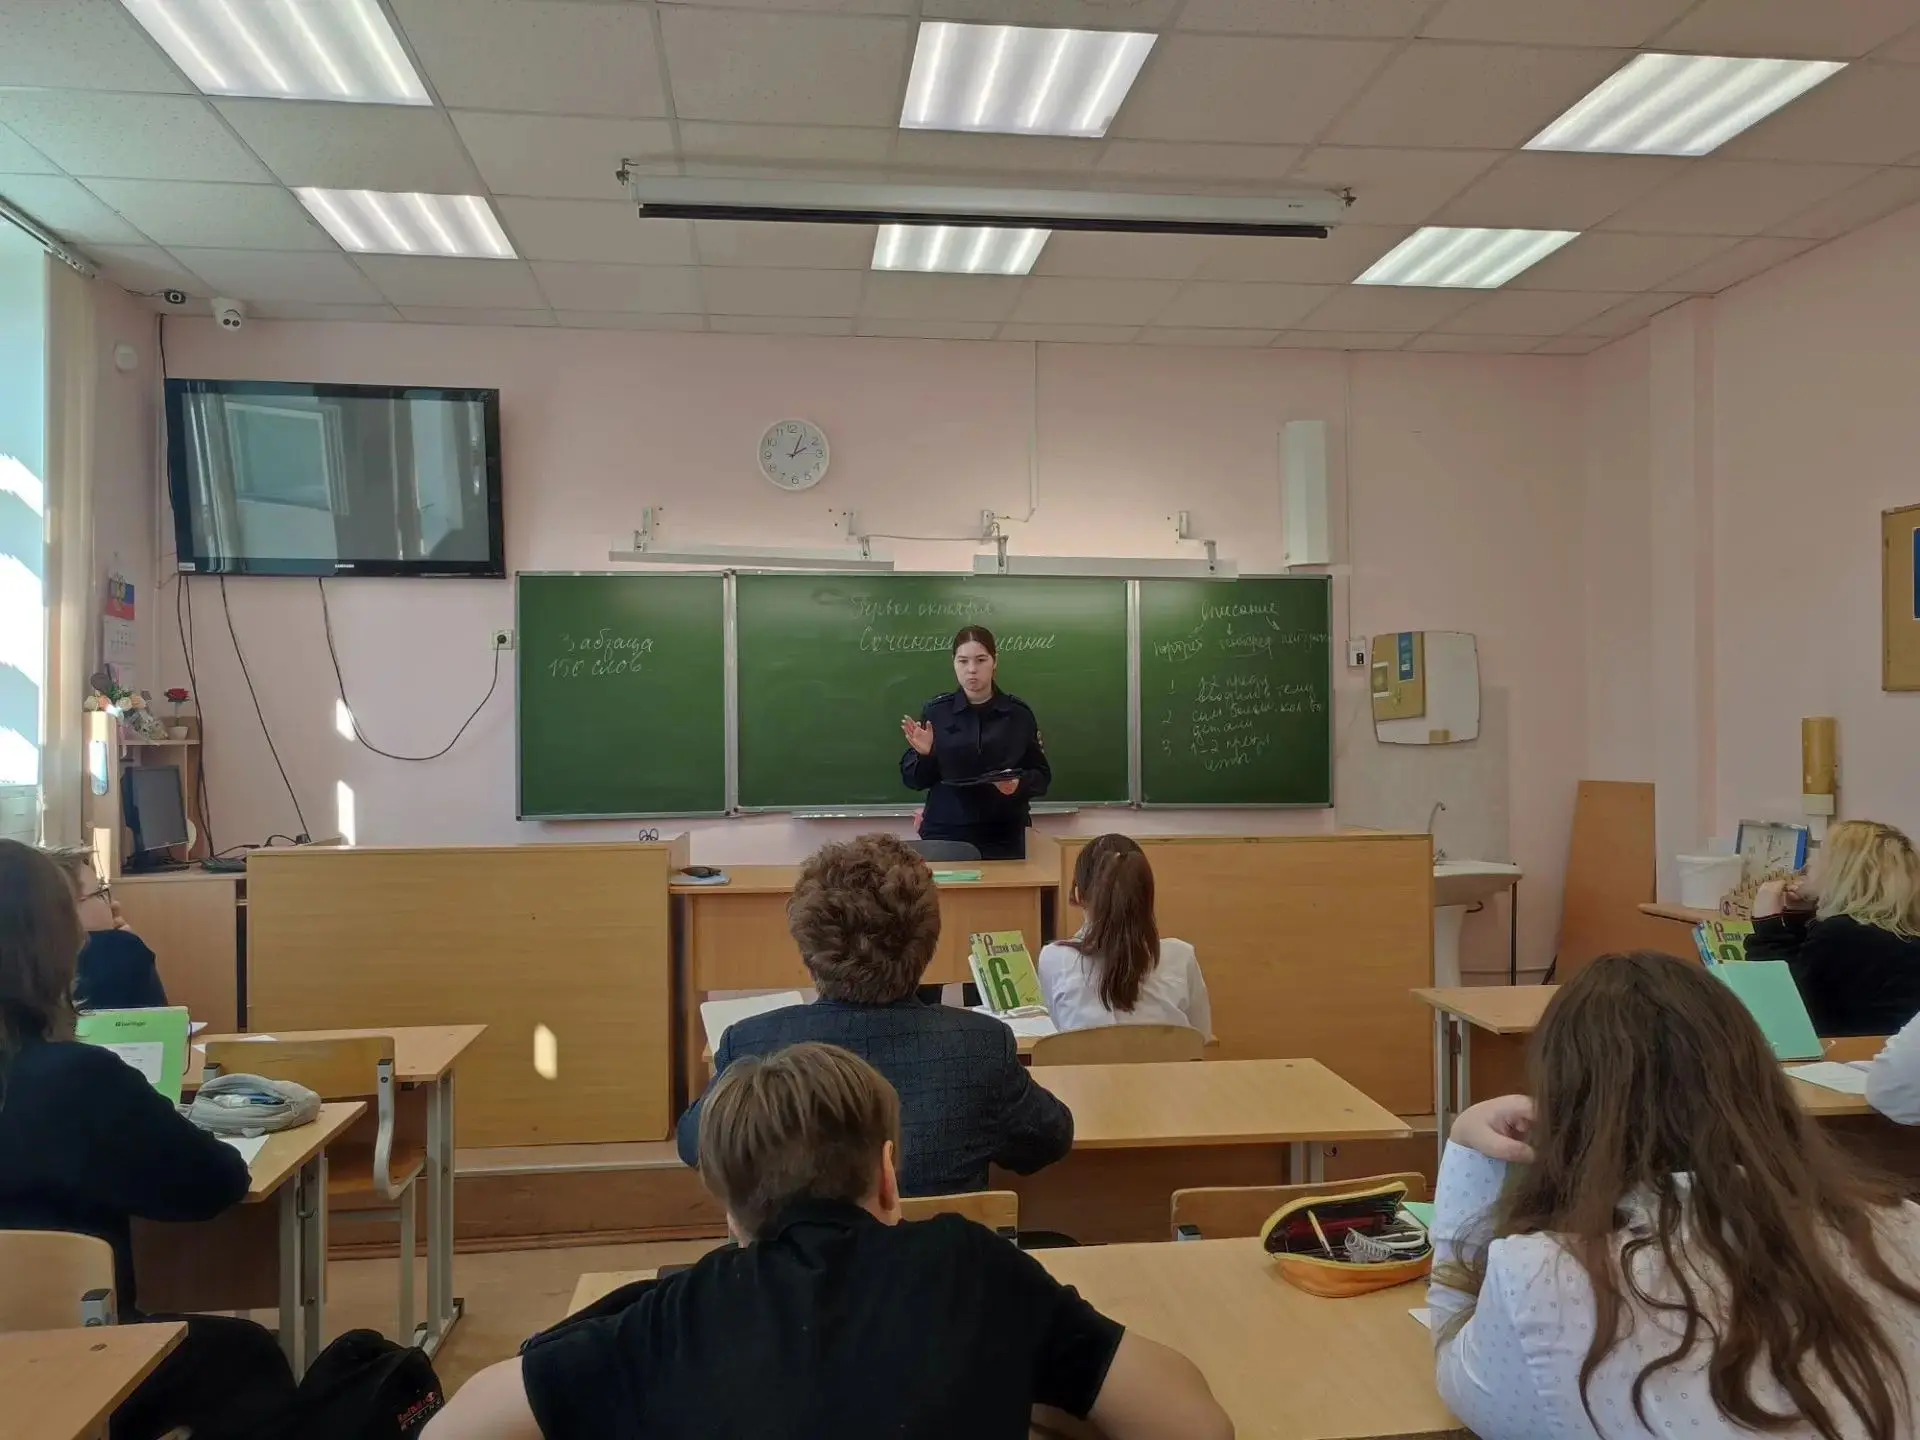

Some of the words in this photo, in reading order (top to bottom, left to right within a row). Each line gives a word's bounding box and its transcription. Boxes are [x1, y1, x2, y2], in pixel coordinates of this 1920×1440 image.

[776, 428, 783, 436] 11
[787, 425, 797, 434] 12
[767, 438, 777, 447] 10
[812, 437, 819, 446] 2
[764, 451, 772, 460] 9
[815, 449, 823, 459] 3
[791, 475, 799, 484] 6
[987, 957, 1020, 1010] 6
